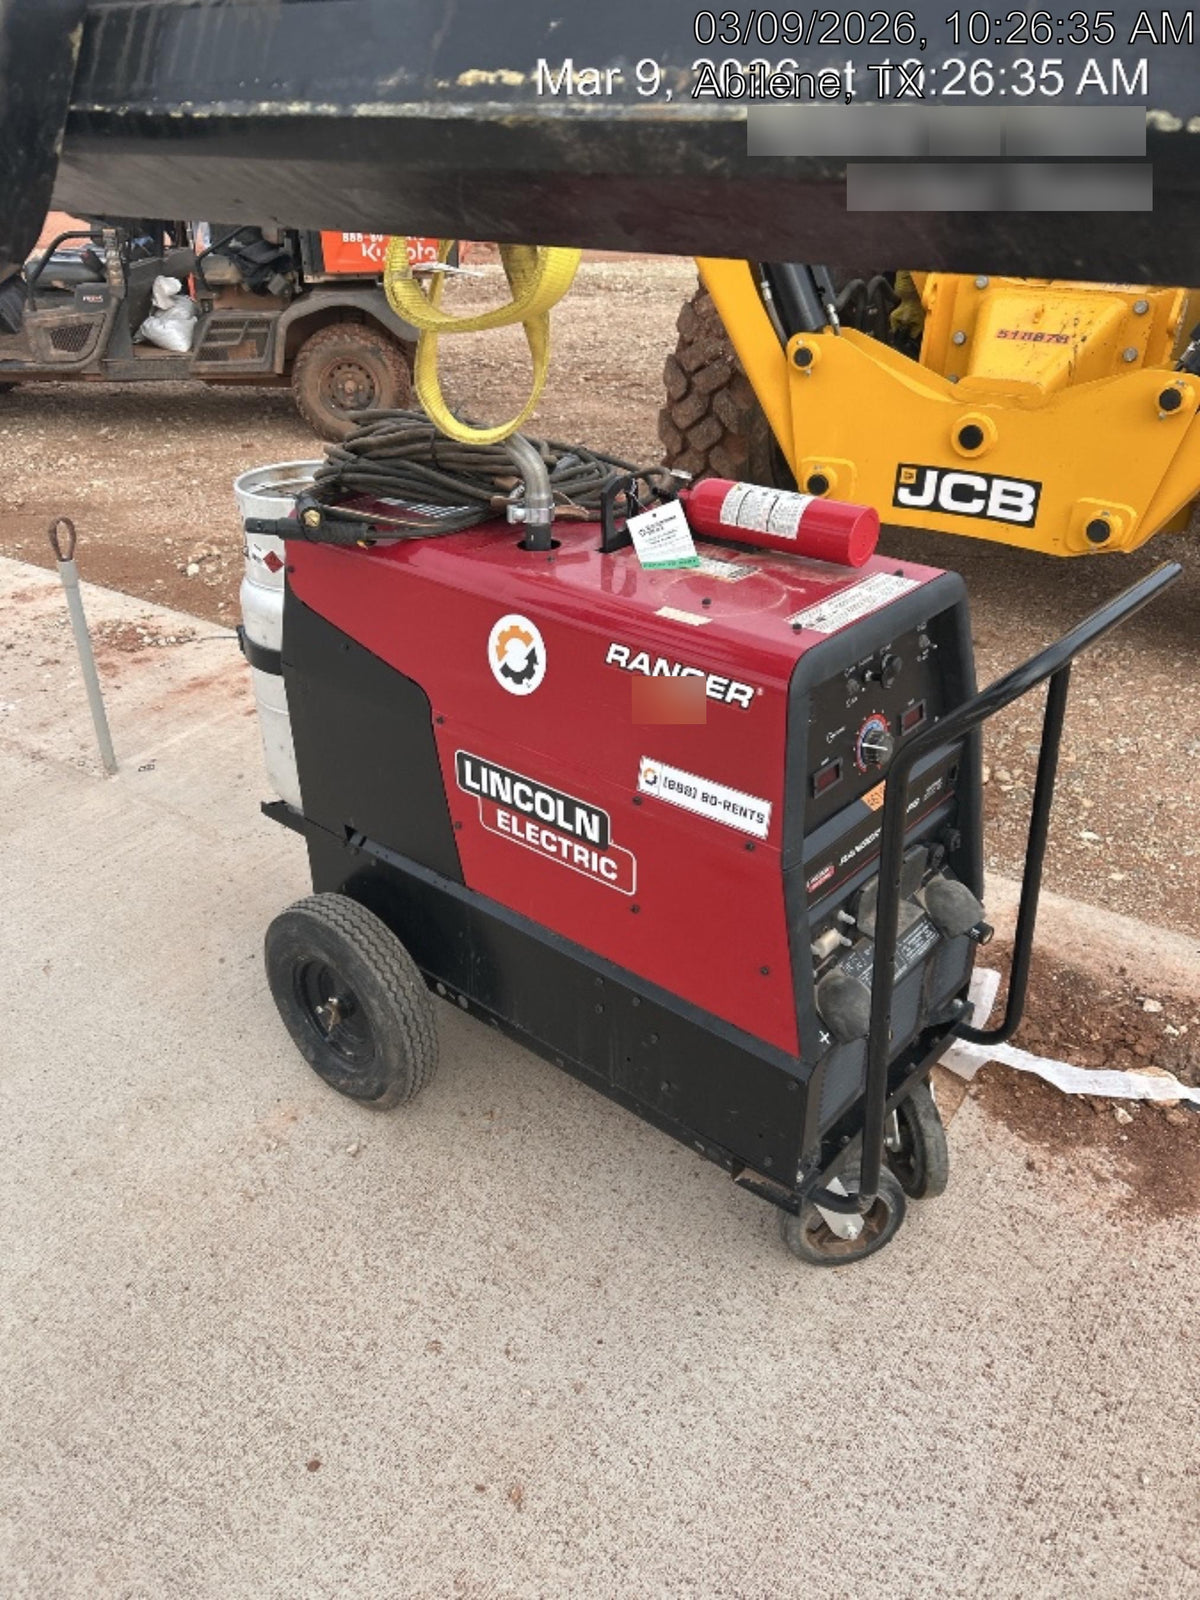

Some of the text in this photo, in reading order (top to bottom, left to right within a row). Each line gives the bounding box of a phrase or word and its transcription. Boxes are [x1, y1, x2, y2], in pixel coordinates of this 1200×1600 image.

[897, 468, 1037, 523] JCB
[463, 760, 600, 843] LINCOLN
[496, 808, 618, 871] ELECTRIC
